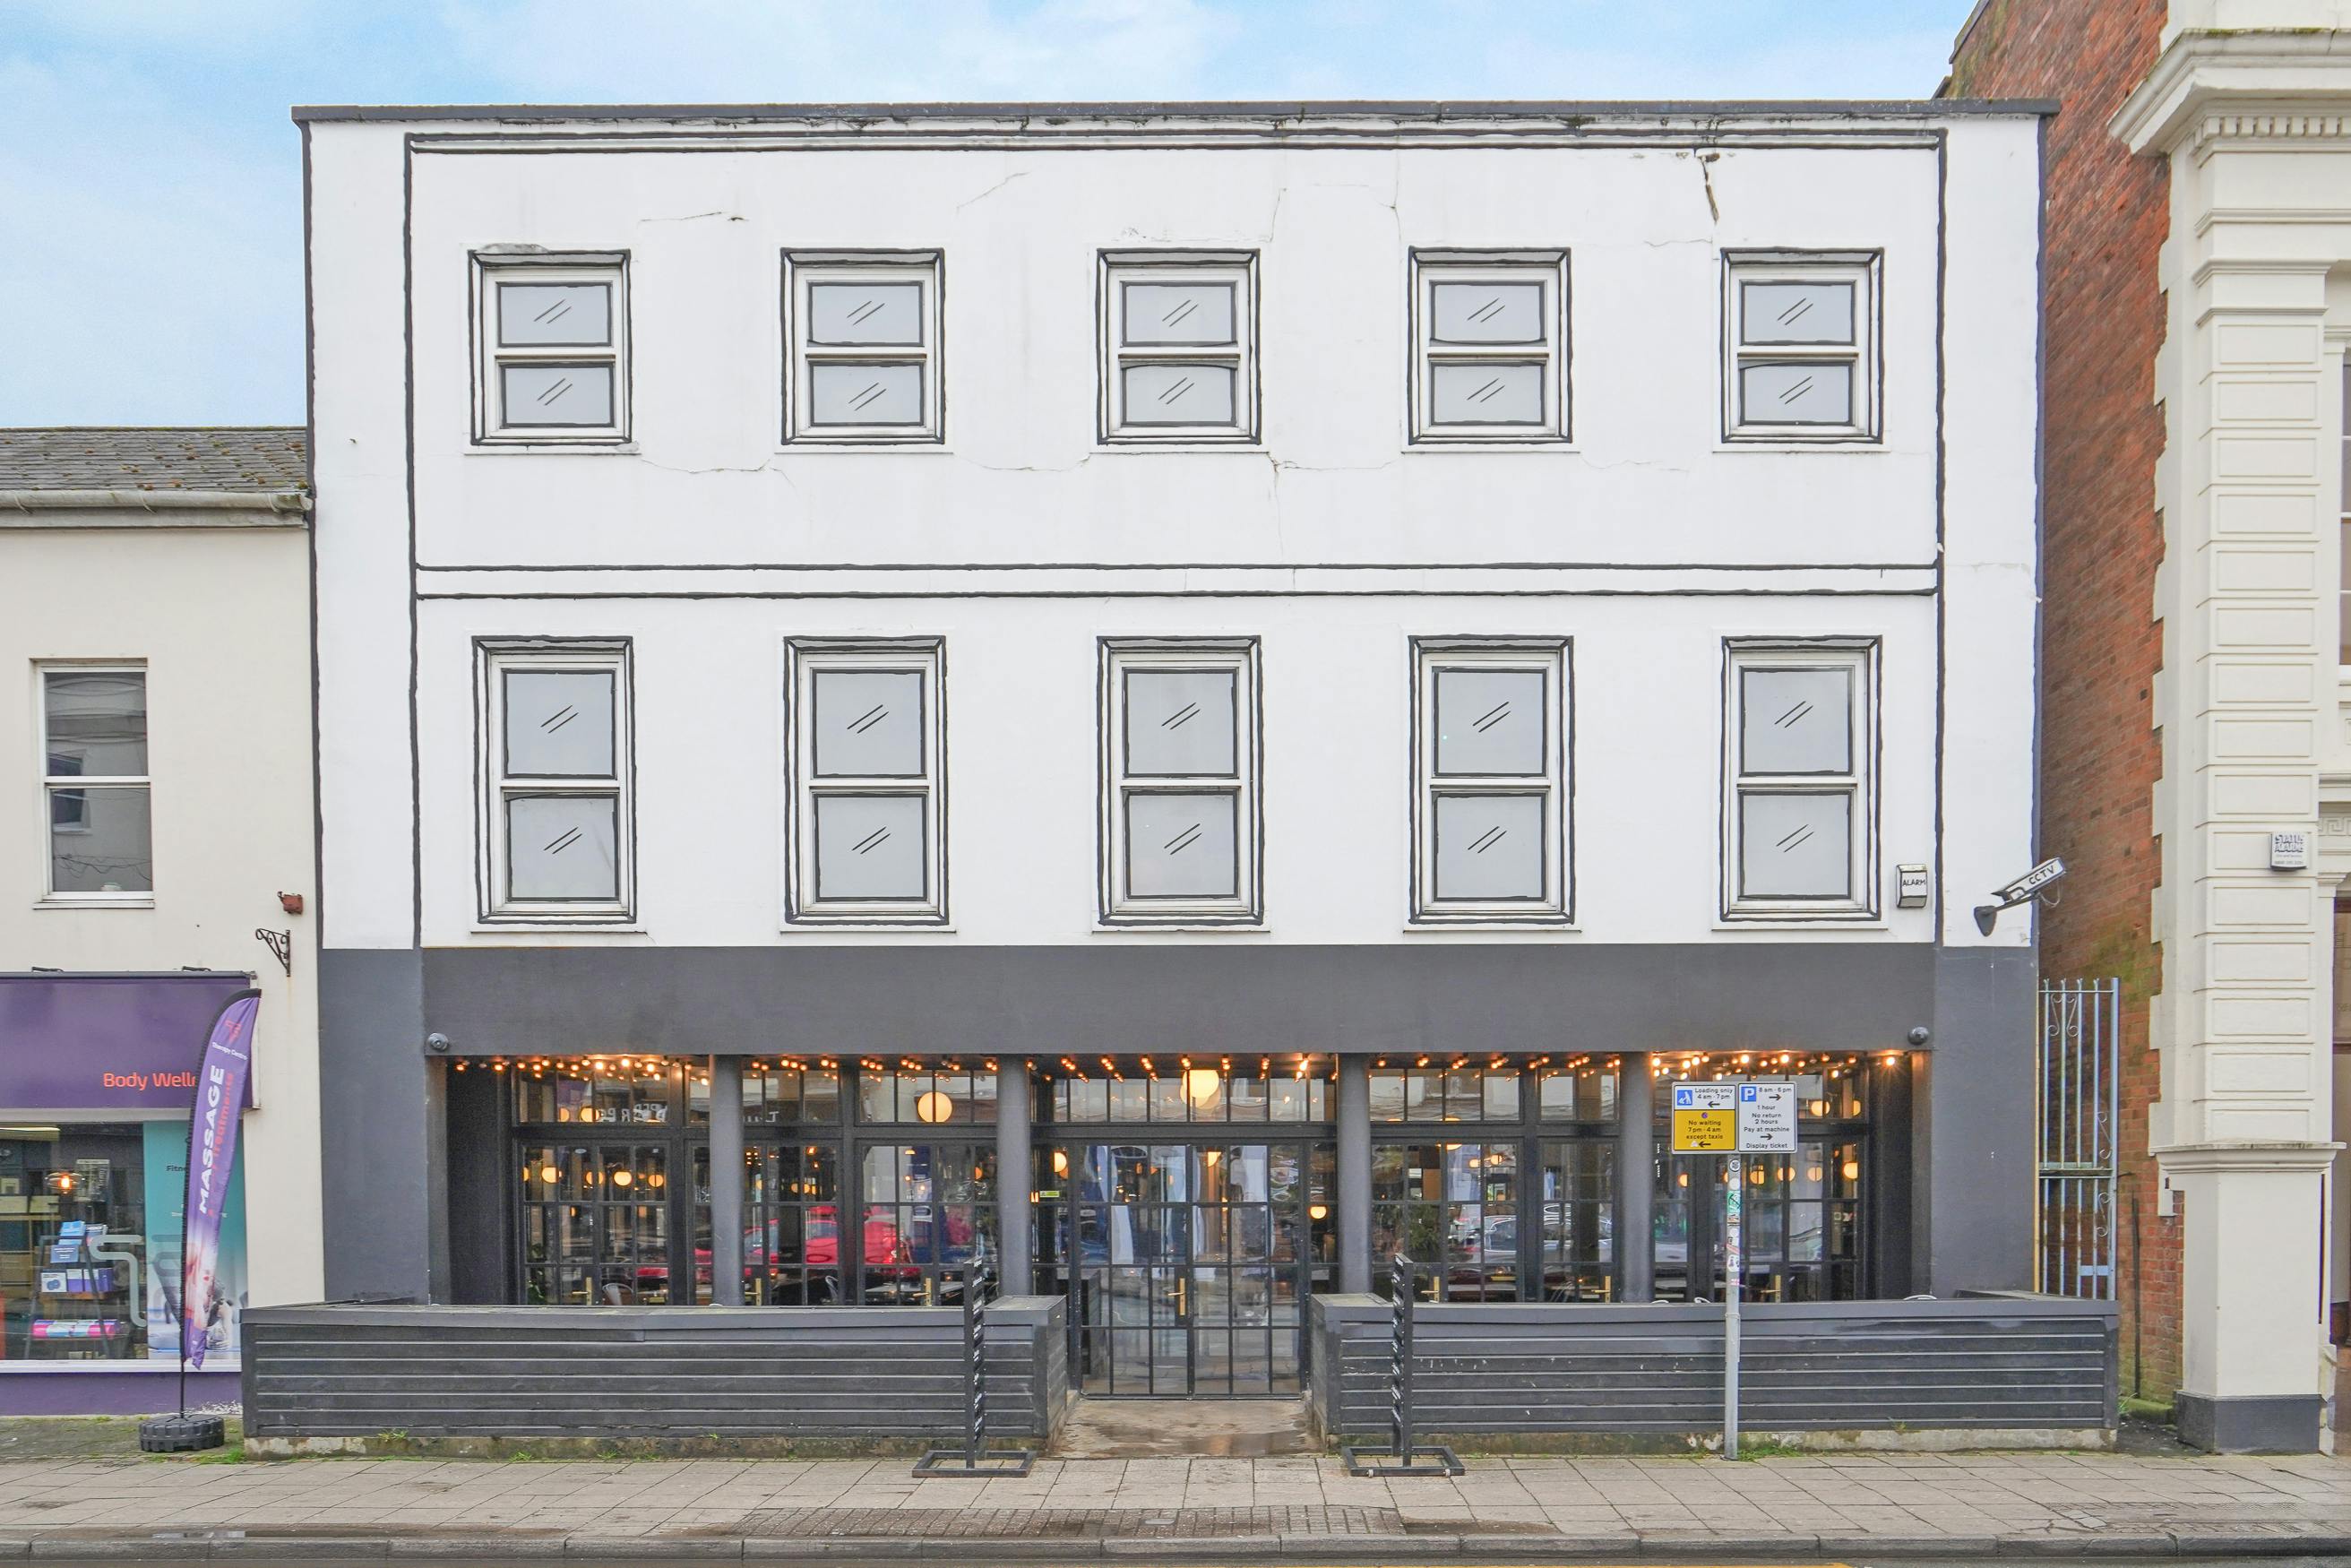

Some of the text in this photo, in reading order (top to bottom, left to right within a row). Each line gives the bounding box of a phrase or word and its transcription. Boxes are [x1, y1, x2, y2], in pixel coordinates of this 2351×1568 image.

[2028, 865, 2055, 885] CCTV
[103, 1072, 148, 1091] Body
[1744, 1088, 1754, 1101] P
[199, 1064, 224, 1214] MASSAGE
